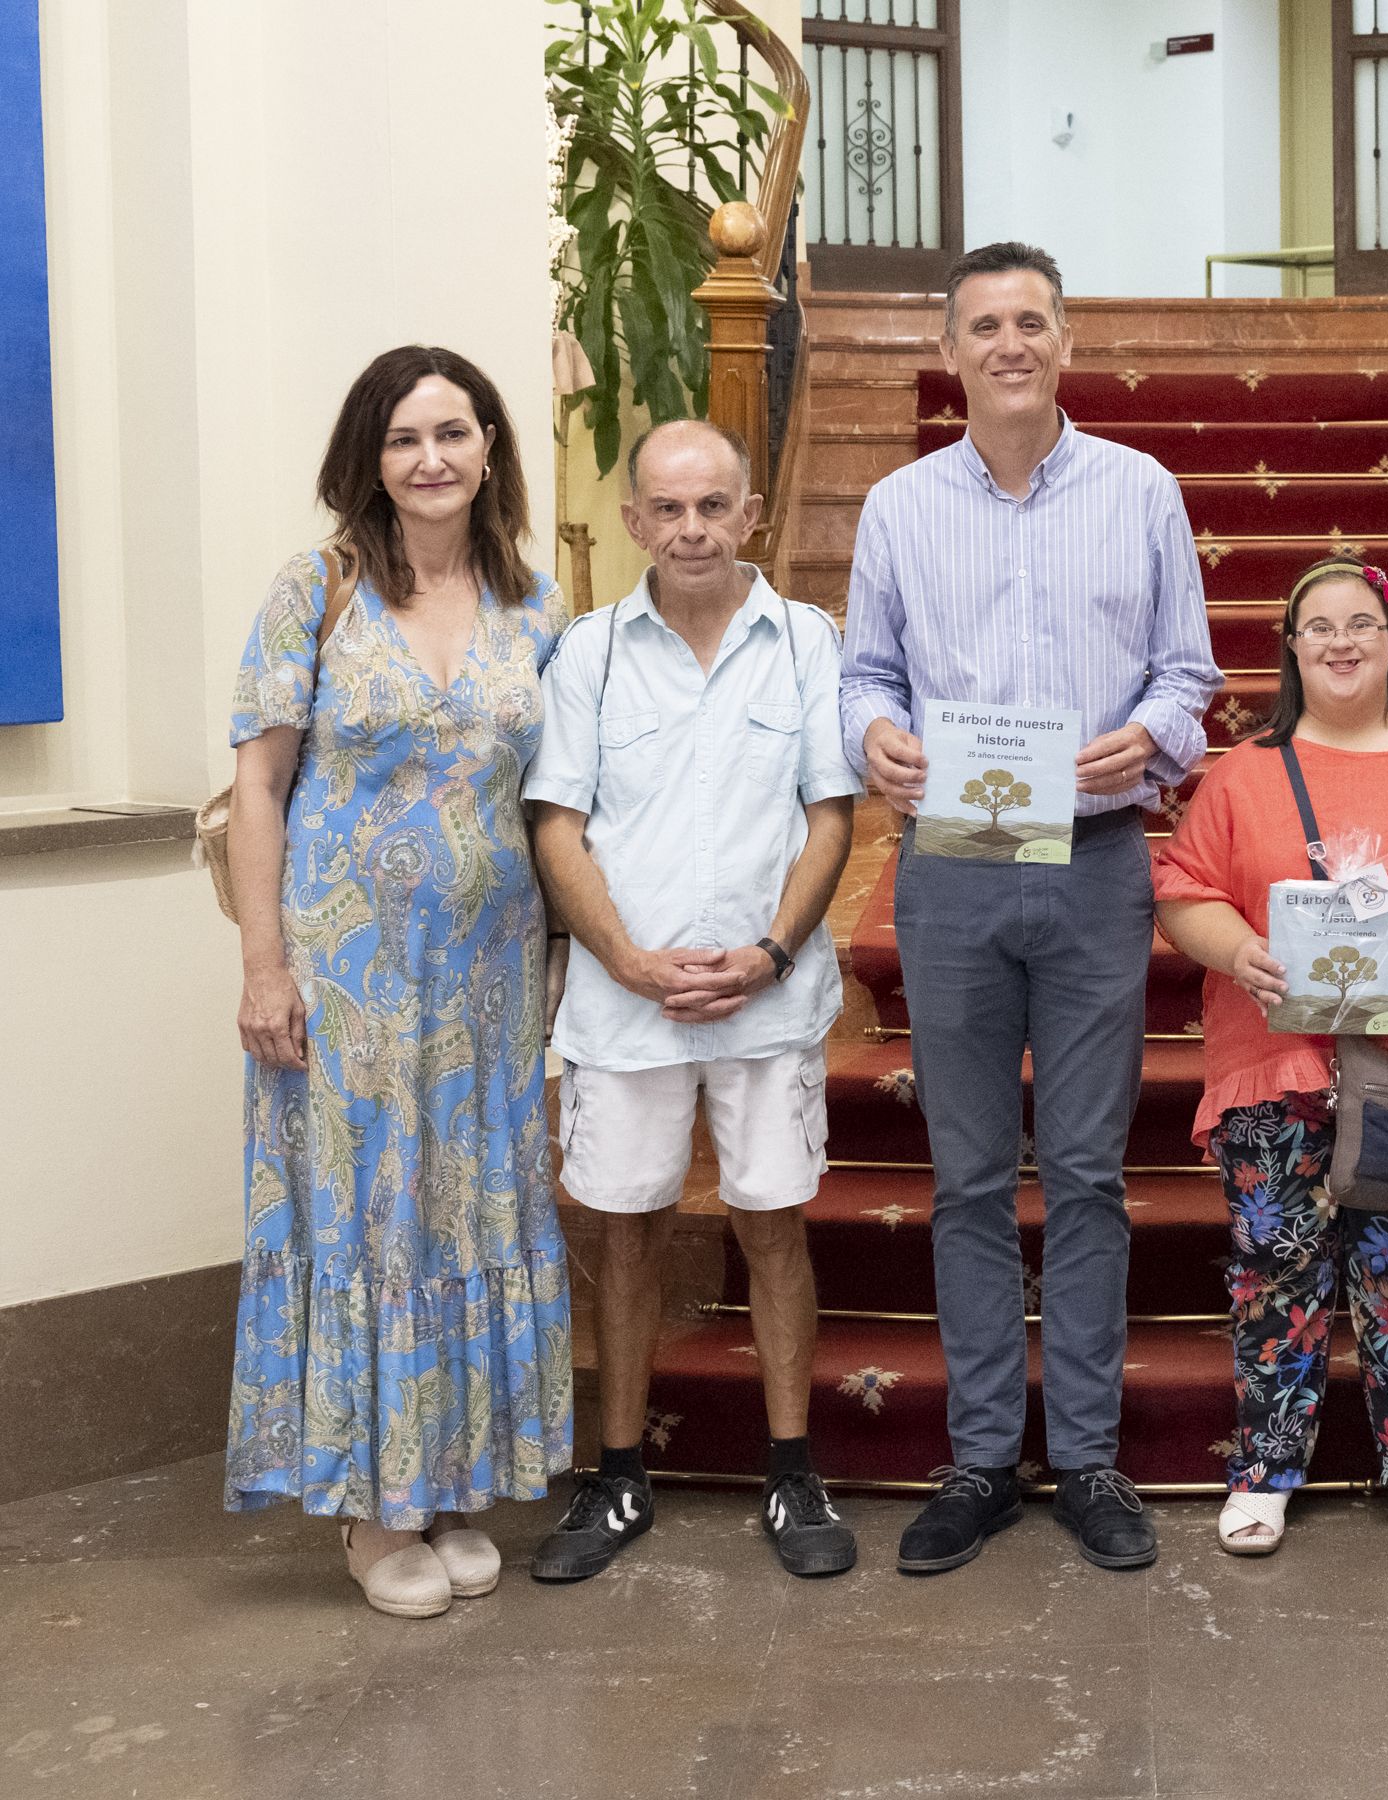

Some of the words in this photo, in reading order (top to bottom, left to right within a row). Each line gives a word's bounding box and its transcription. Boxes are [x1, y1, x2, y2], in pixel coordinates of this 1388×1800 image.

[942, 711, 954, 723] El
[958, 713, 991, 726] árbol
[995, 716, 1011, 727] de
[1015, 719, 1064, 731] nuestra
[977, 733, 1026, 747] historia
[977, 751, 996, 759] años
[996, 754, 1033, 762] creciendo
[1286, 894, 1298, 905] El
